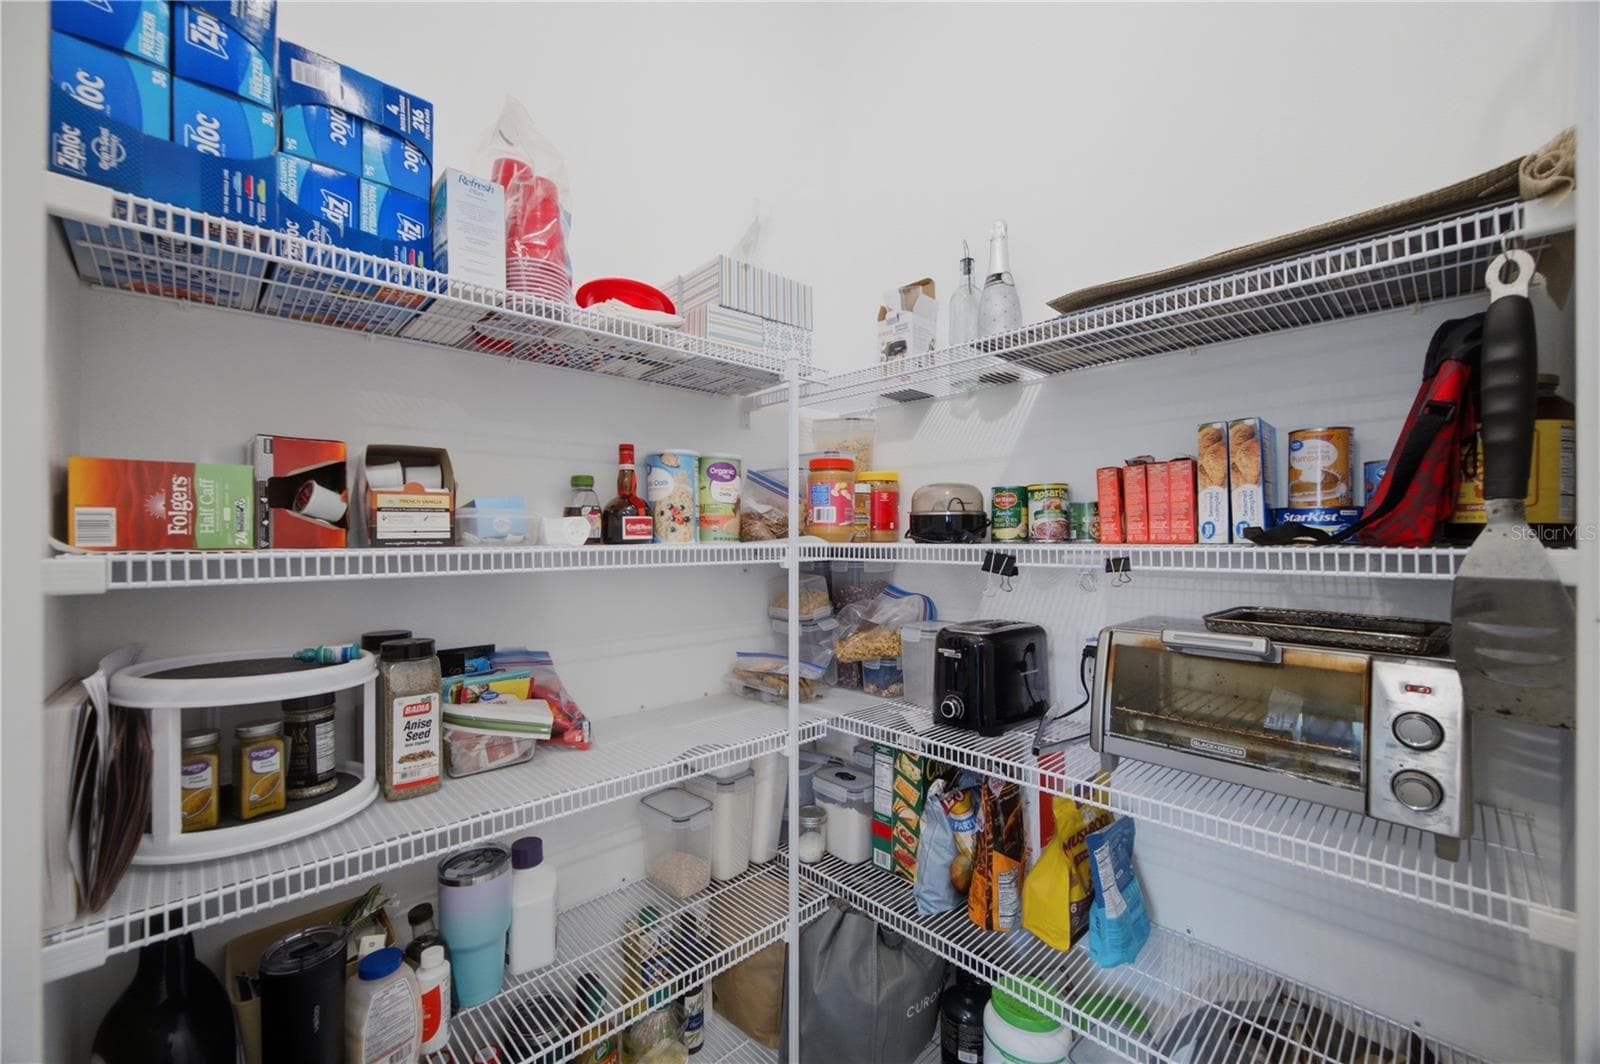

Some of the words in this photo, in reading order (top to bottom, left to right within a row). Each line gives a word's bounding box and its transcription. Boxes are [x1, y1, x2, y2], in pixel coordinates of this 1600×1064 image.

[190, 12, 229, 50] Zip
[70, 70, 105, 110] loc
[386, 104, 399, 115] 4
[412, 108, 425, 133] 216
[58, 122, 86, 170] Ziploc
[458, 174, 495, 194] Refresh
[397, 219, 422, 242] Zip
[710, 466, 735, 476] Organic
[199, 477, 215, 505] Caff
[167, 476, 193, 536] Folgers
[1283, 511, 1338, 522] StarKist
[199, 508, 215, 534] Half
[404, 703, 431, 715] BADIA
[404, 718, 433, 731] Anise
[405, 728, 431, 742] Seed
[953, 819, 973, 831] PART
[1070, 904, 1078, 913] 6
[906, 987, 940, 1018] CURO
